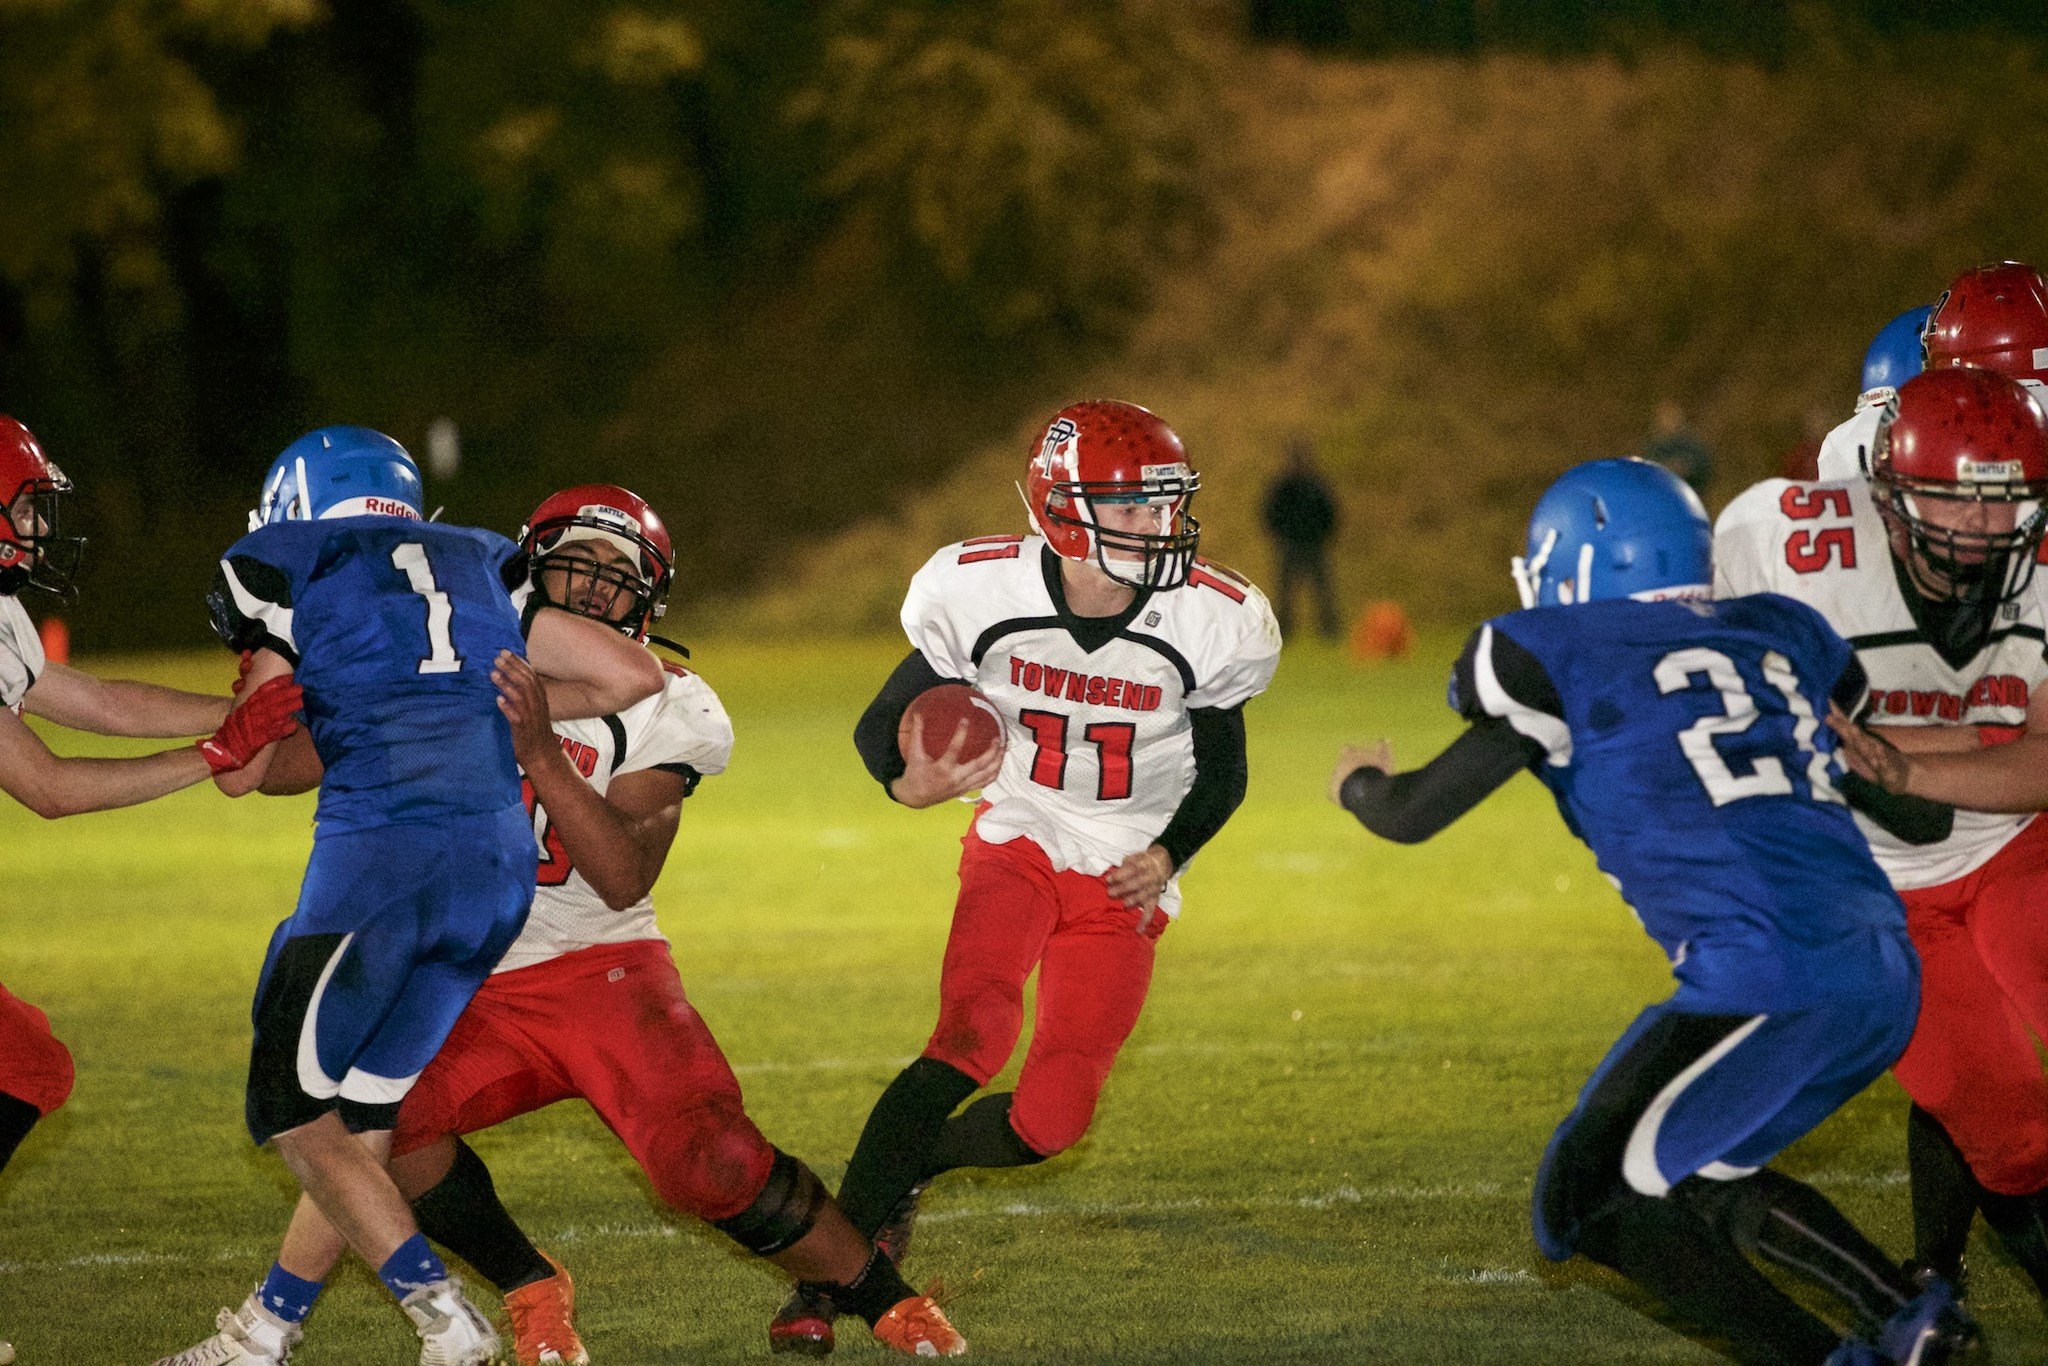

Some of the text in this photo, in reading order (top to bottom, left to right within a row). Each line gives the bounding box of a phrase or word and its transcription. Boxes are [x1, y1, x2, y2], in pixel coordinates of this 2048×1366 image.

[598, 506, 626, 519] BATTLE
[1779, 484, 1858, 575] 55
[390, 541, 464, 675] 1
[1009, 655, 1163, 711] TOWNSEND
[1868, 674, 2029, 722] TOWNEND
[1018, 707, 1137, 801] 11
